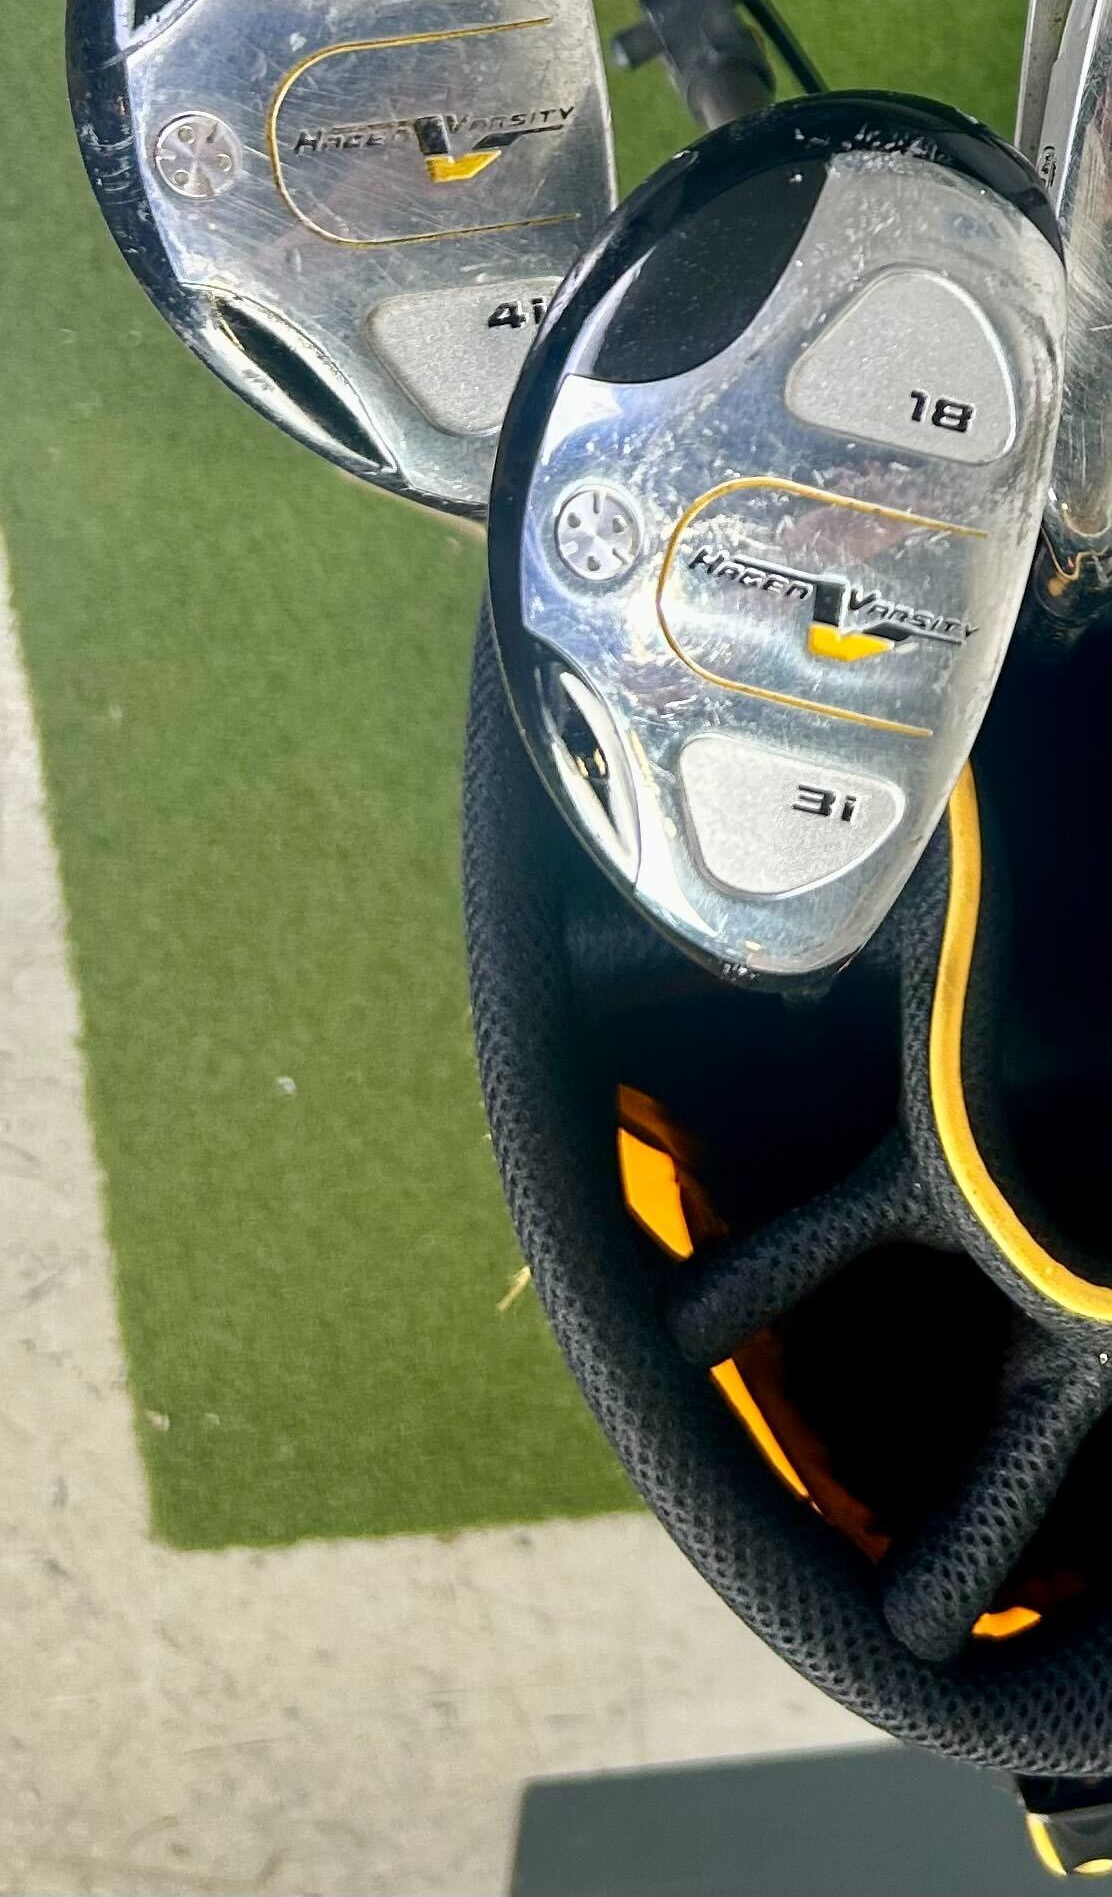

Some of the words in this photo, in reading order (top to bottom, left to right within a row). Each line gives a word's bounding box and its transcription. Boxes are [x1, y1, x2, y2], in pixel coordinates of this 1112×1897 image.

[488, 296, 545, 329] 4i
[909, 388, 976, 435] 18
[790, 783, 858, 824] 3i
